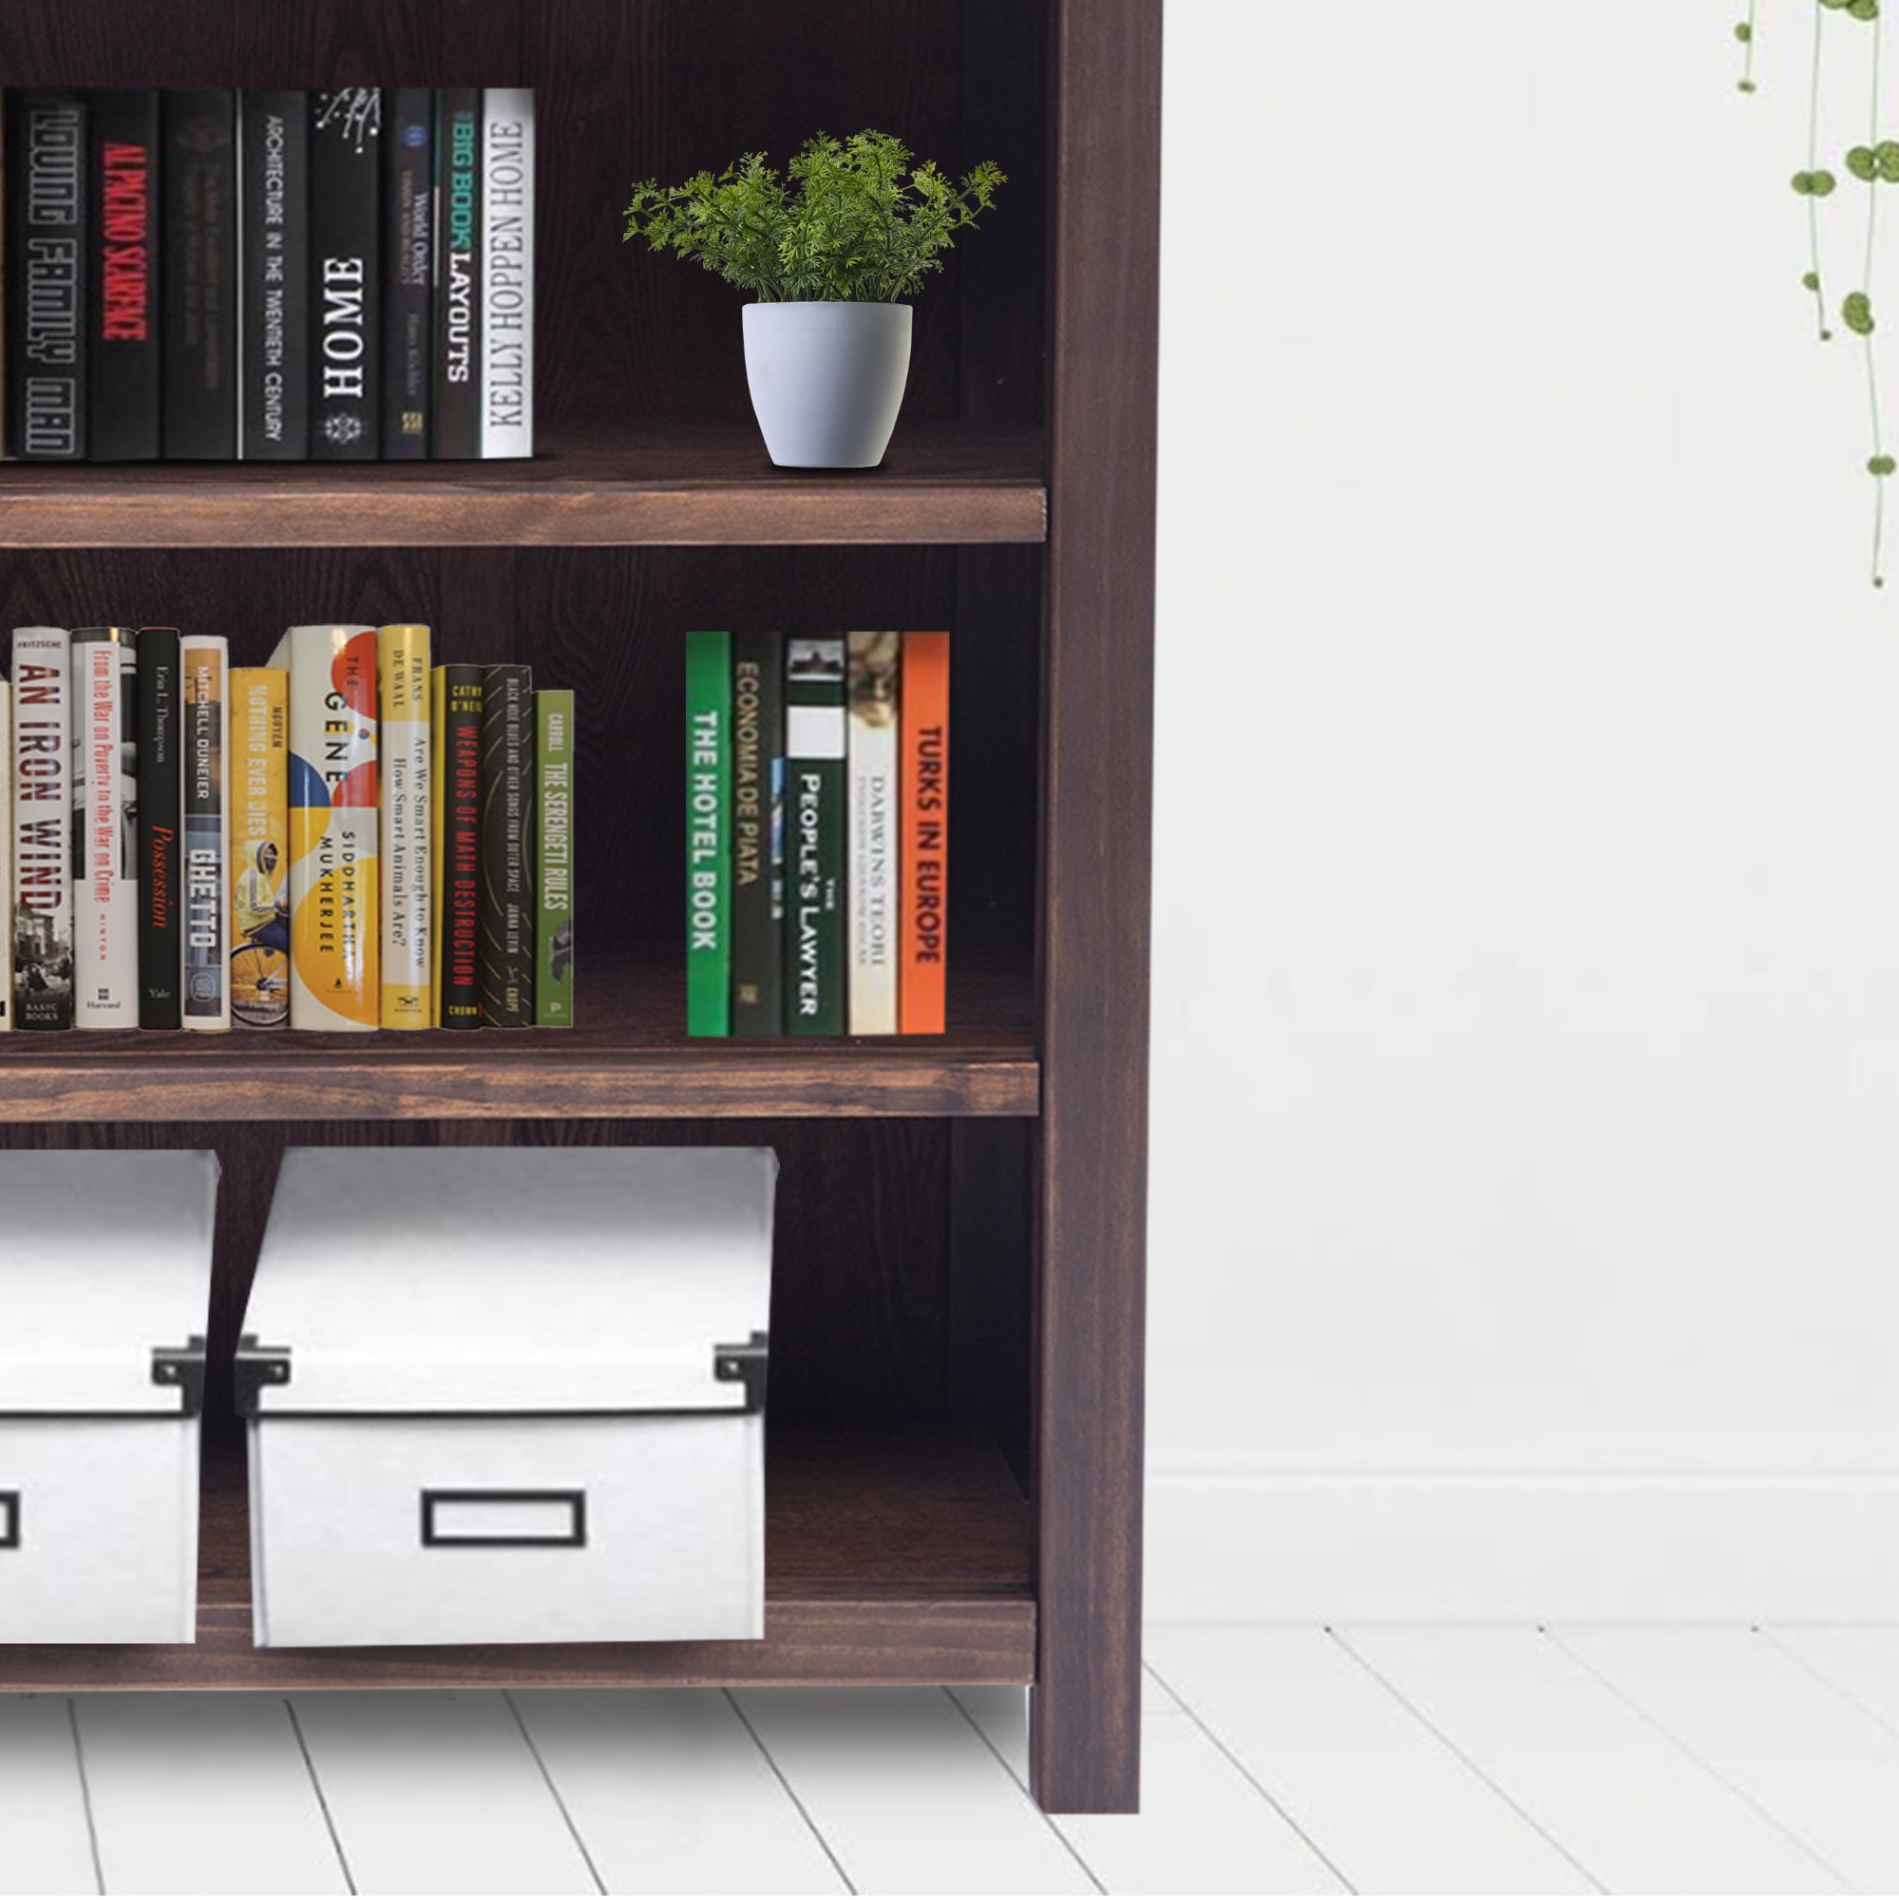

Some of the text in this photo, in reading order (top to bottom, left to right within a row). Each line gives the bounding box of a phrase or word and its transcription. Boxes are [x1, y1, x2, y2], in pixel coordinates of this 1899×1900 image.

[453, 121, 474, 167] BIG
[103, 143, 148, 340] AL PACINO SCARFACE
[411, 192, 428, 285] World Order
[451, 172, 473, 249] BOOK
[26, 111, 77, 454] LOVING FAMILY MAN
[265, 115, 282, 441] ARCHITECTURE IN THE TWENTIETH CENTURY
[323, 258, 363, 398] HOME
[448, 252, 470, 382] LAYOUTS
[489, 121, 523, 428] KELLY HOPPEN HOME
[156, 666, 168, 689] Erin
[346, 656, 359, 687] THE
[393, 650, 405, 709] DE WAAL
[412, 658, 423, 701] FRANS
[507, 678, 519, 701] BLACK
[91, 650, 115, 903] From the War on Poverty to the War on Crime
[153, 706, 168, 763] Thompson
[196, 666, 210, 799] MITCHELL DUNEIER
[248, 685, 268, 836] NOTHING EVER DIES
[272, 706, 283, 748] NGUYEN
[325, 691, 348, 783] GENE
[507, 749, 519, 763] AND
[507, 767, 519, 789] OTHER
[548, 713, 564, 752] CARROLL
[738, 662, 757, 885] ECONOMIA DE PIATA
[18, 664, 62, 910] AN IRON WIND
[507, 792, 519, 817] SONGS
[507, 819, 519, 839] FROM
[544, 763, 568, 910] THE SERENGETI RULES
[692, 711, 717, 950] THE HOTEL BOOK
[151, 826, 173, 929] Possession
[189, 849, 217, 948] GHETTO
[319, 836, 333, 954] MUKHERJEE
[342, 832, 356, 960] SIDDHARTHA
[392, 758, 406, 948] How Smart Animals Are?
[413, 737, 427, 969] Are We Smart Enough to Know
[453, 726, 477, 986] WEAPONS OF MATH DESTRUCTION
[507, 843, 520, 865] OUTER
[507, 869, 520, 892] SPACE
[799, 774, 820, 1015] PEOPLE'S LAWYER
[872, 776, 885, 966] DARWINS TEORI
[917, 727, 942, 963] TURKS IN EUROPE
[507, 904, 518, 953] JANNA LEVIN
